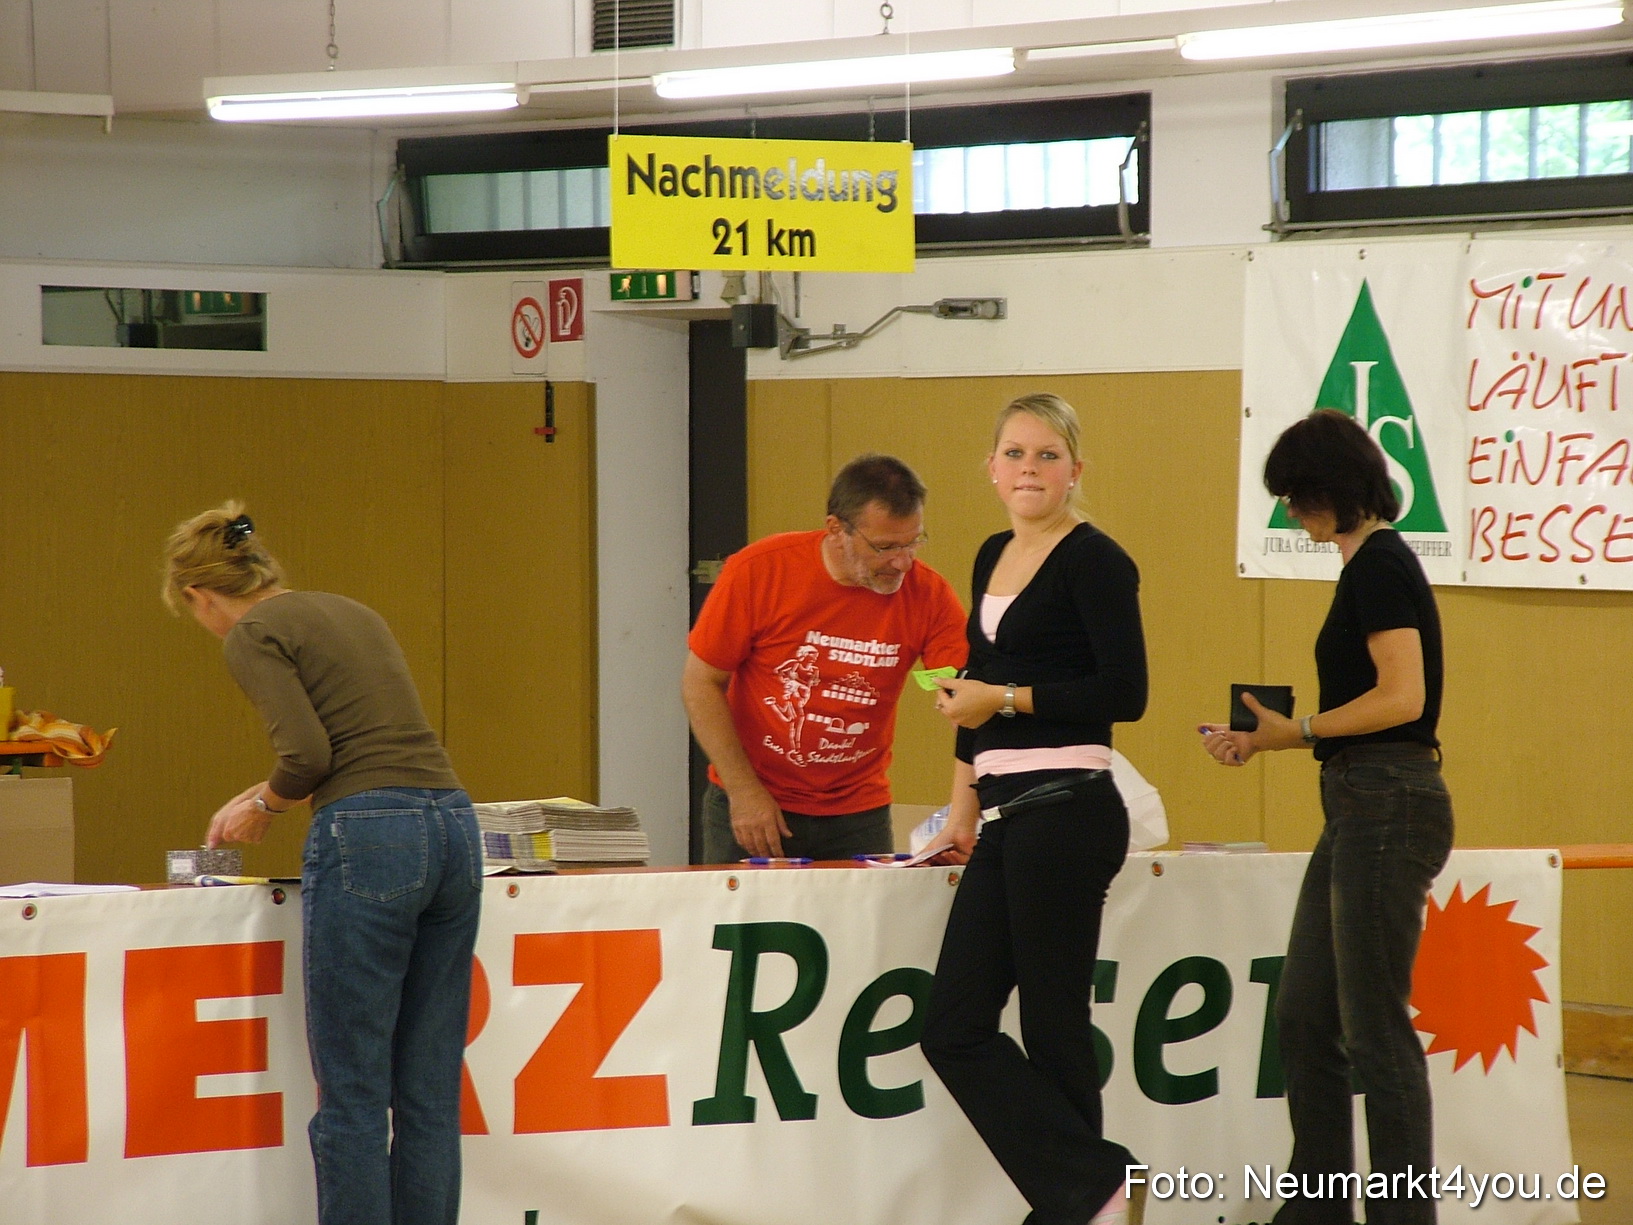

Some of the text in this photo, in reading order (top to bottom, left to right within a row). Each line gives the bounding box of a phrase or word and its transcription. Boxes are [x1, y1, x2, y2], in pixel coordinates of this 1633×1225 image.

[627, 152, 899, 213] Nachmeldung
[712, 217, 817, 257] 21 km
[1468, 351, 1629, 413] LÄUFT
[1262, 537, 1293, 557] JURA
[804, 630, 901, 656] Neumarkter
[828, 649, 900, 668] STADTLAUF
